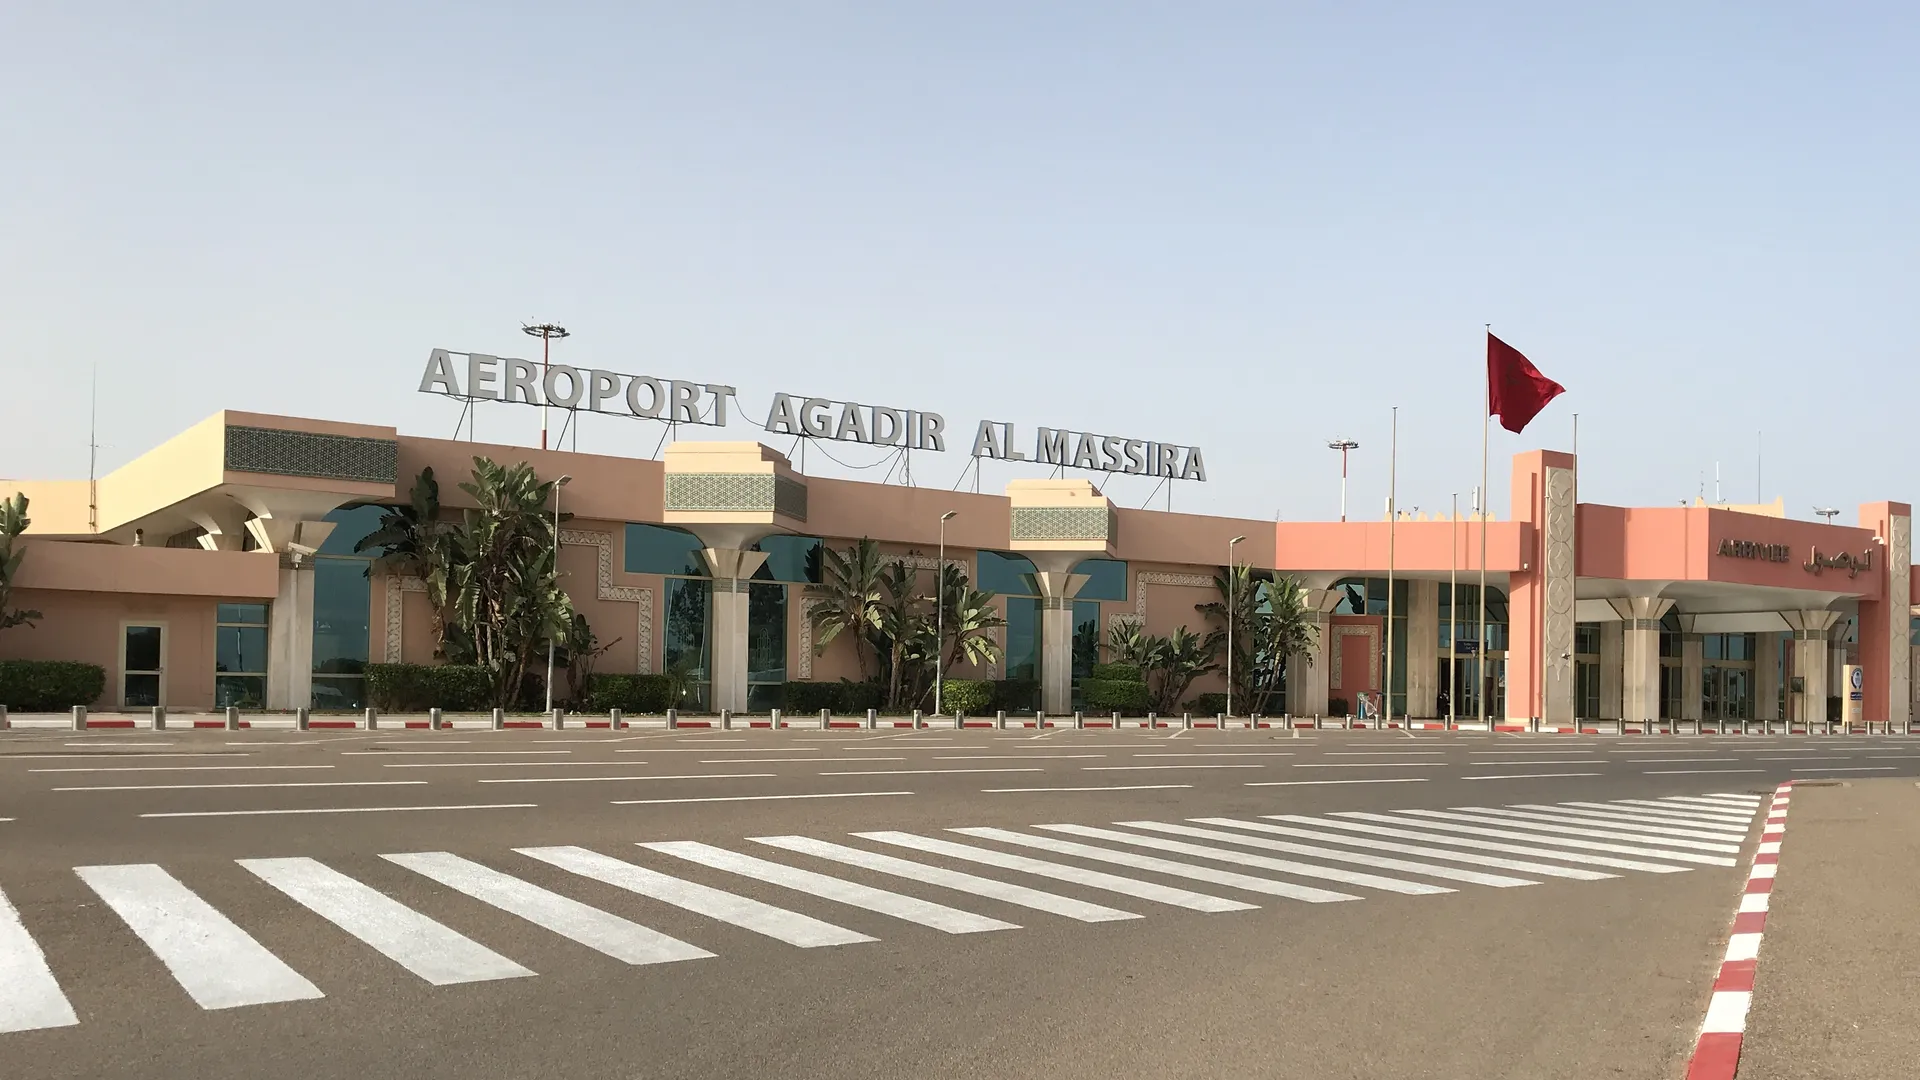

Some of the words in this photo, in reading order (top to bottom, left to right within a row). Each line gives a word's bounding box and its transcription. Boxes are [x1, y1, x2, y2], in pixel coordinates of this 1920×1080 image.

[418, 348, 736, 427] AEROPORT
[765, 392, 946, 452] AGADIR
[972, 419, 1025, 461] AL
[1036, 426, 1207, 482] MASSIRA
[1803, 545, 1873, 579] الوصول
